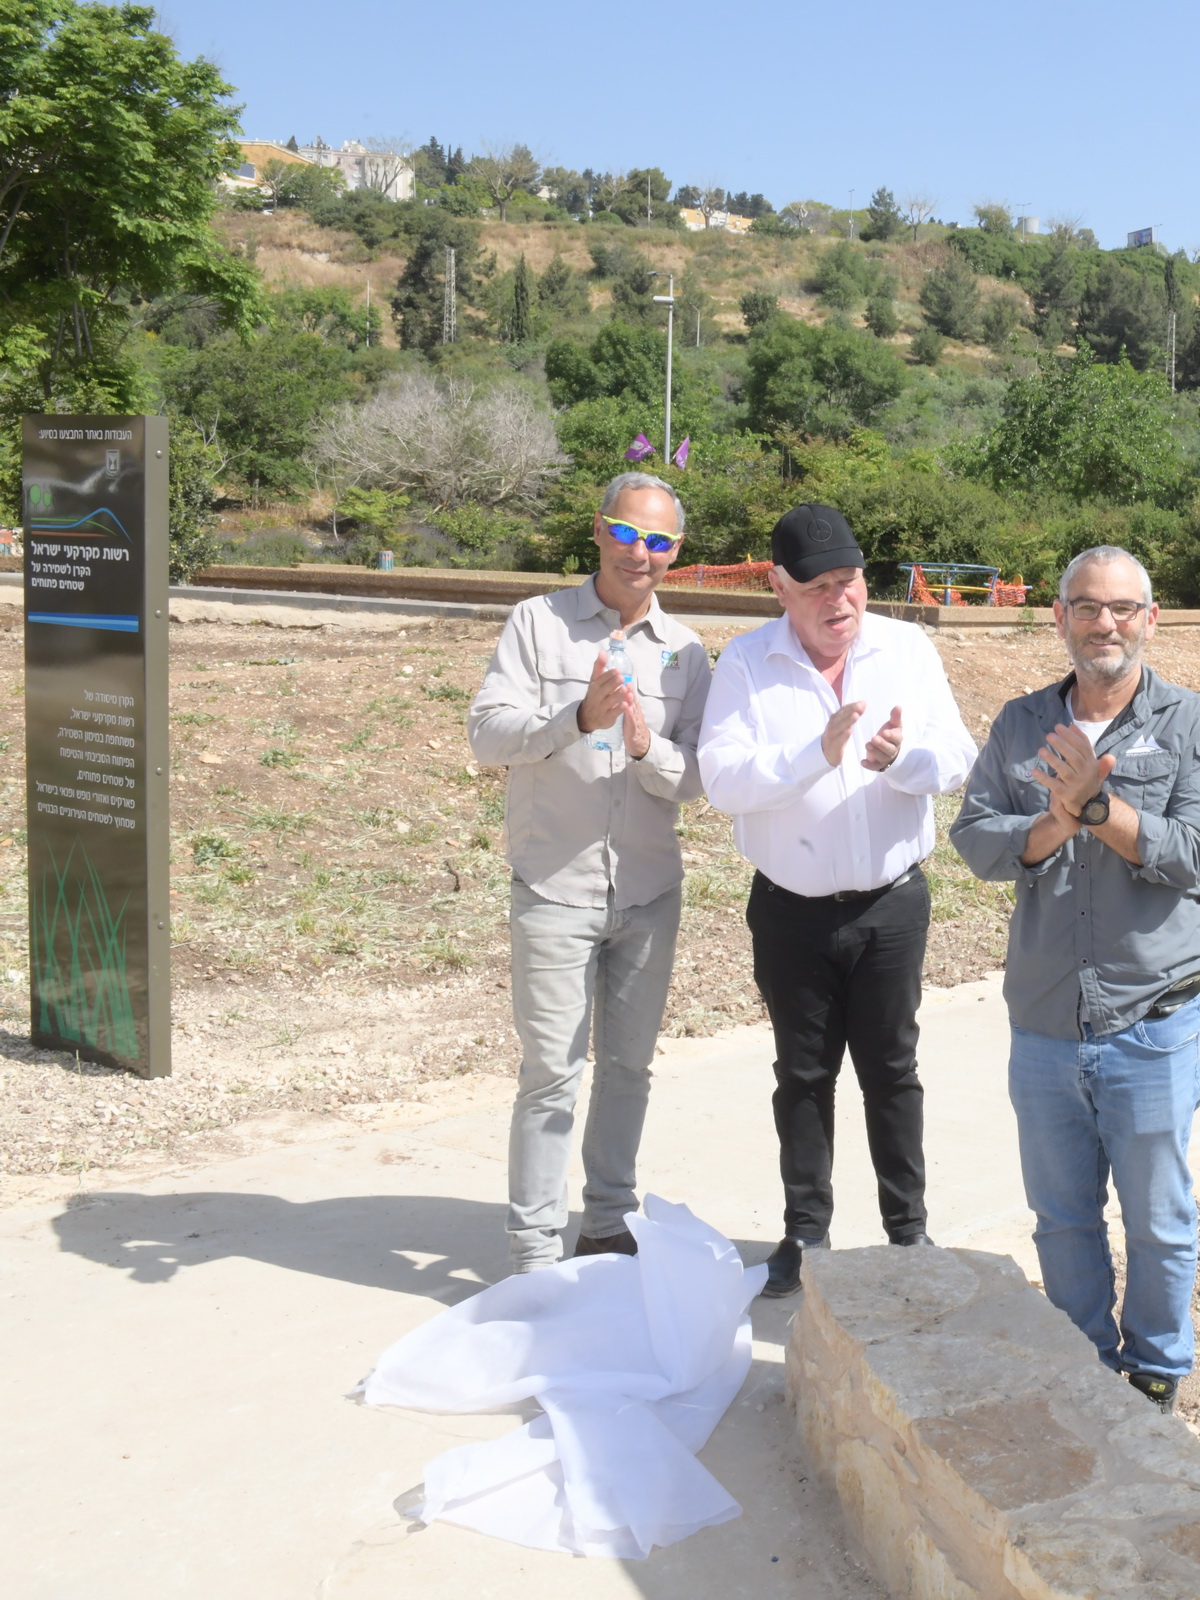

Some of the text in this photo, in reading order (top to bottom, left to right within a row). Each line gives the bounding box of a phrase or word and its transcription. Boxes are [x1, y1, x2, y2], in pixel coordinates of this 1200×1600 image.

[58, 429, 83, 439] התבצעו
[84, 429, 103, 440] באתר
[103, 429, 132, 440] העבודות
[30, 540, 129, 561] רשות מקרקעי ישראל
[30, 560, 91, 577] הקרן לשמירה על
[31, 577, 84, 591] שטחים פתוחים
